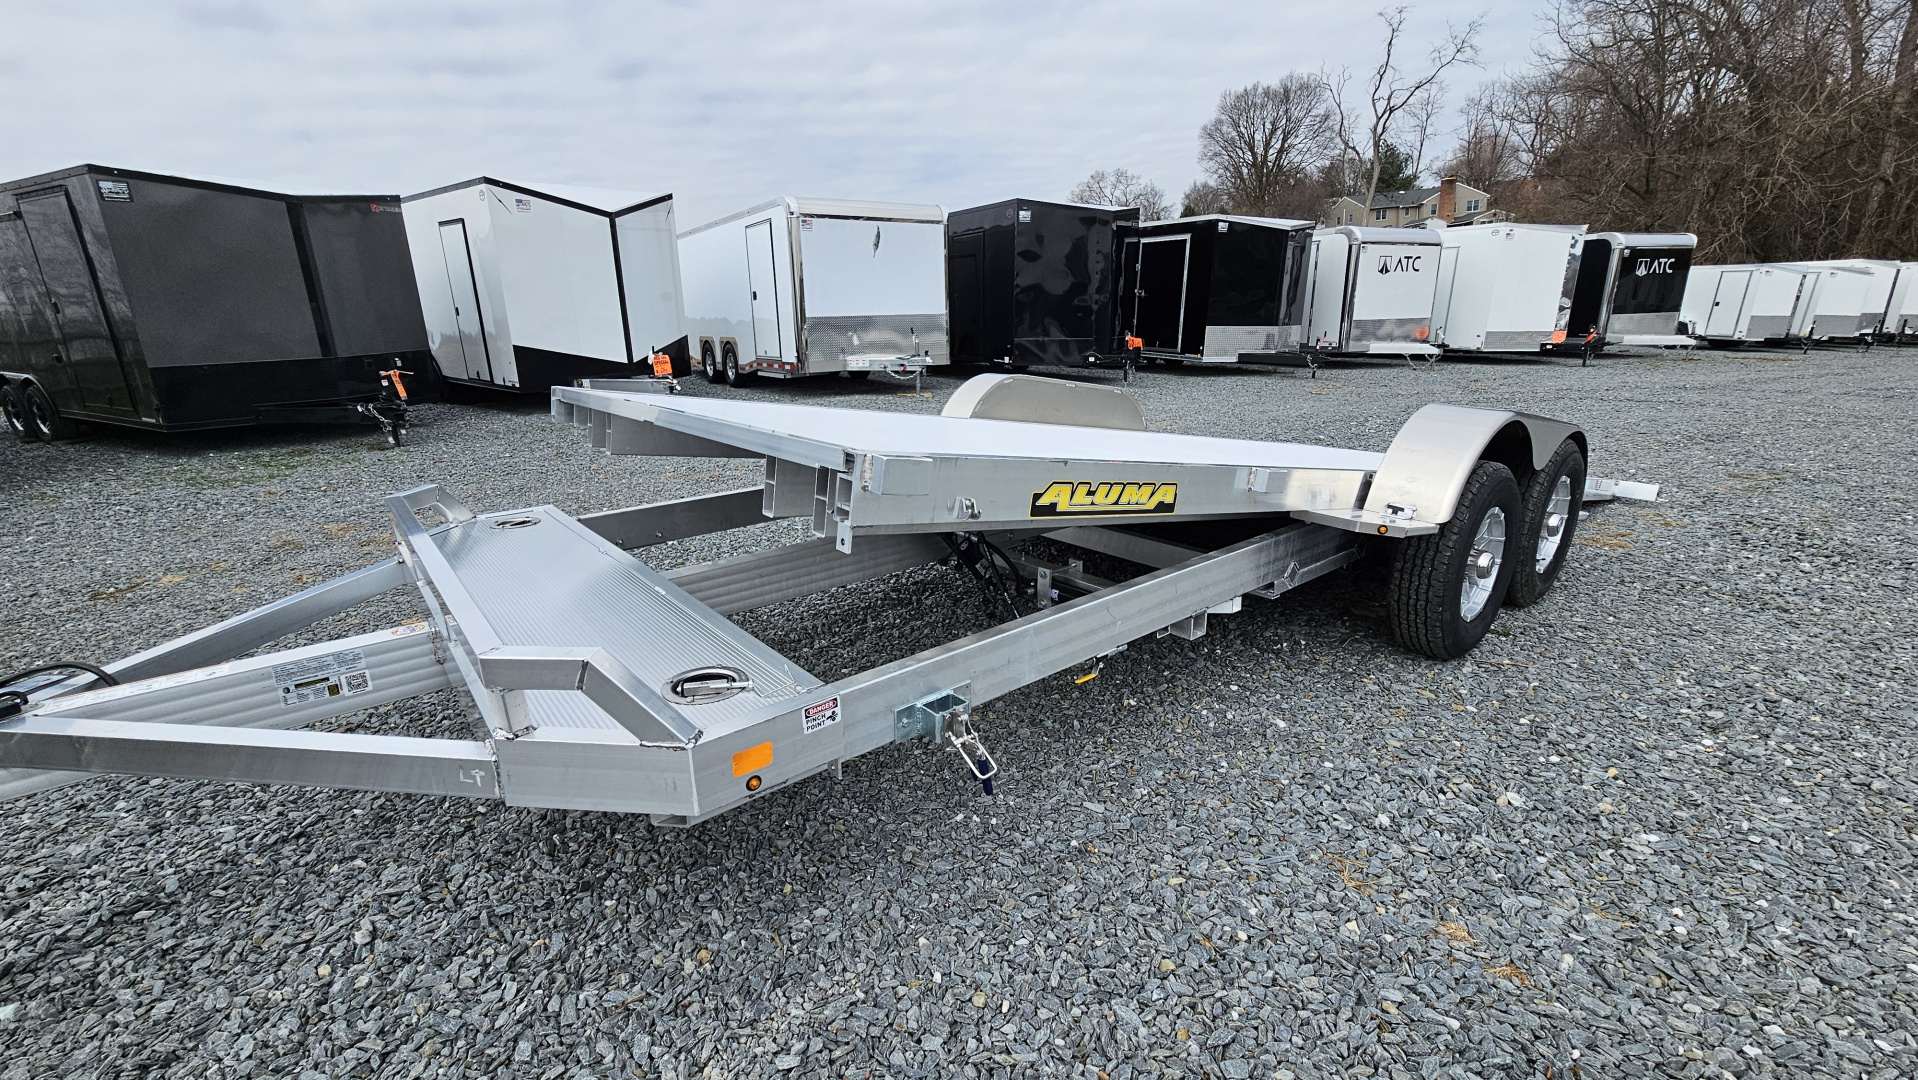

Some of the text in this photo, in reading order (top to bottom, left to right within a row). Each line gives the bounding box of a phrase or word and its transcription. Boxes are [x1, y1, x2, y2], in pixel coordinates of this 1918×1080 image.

[1393, 256, 1421, 272] ATC
[1649, 258, 1675, 273] ATC
[1035, 483, 1177, 512] ALUMA
[809, 701, 834, 715] DANGER
[805, 713, 826, 726] PINCH
[806, 720, 826, 732] POINT
